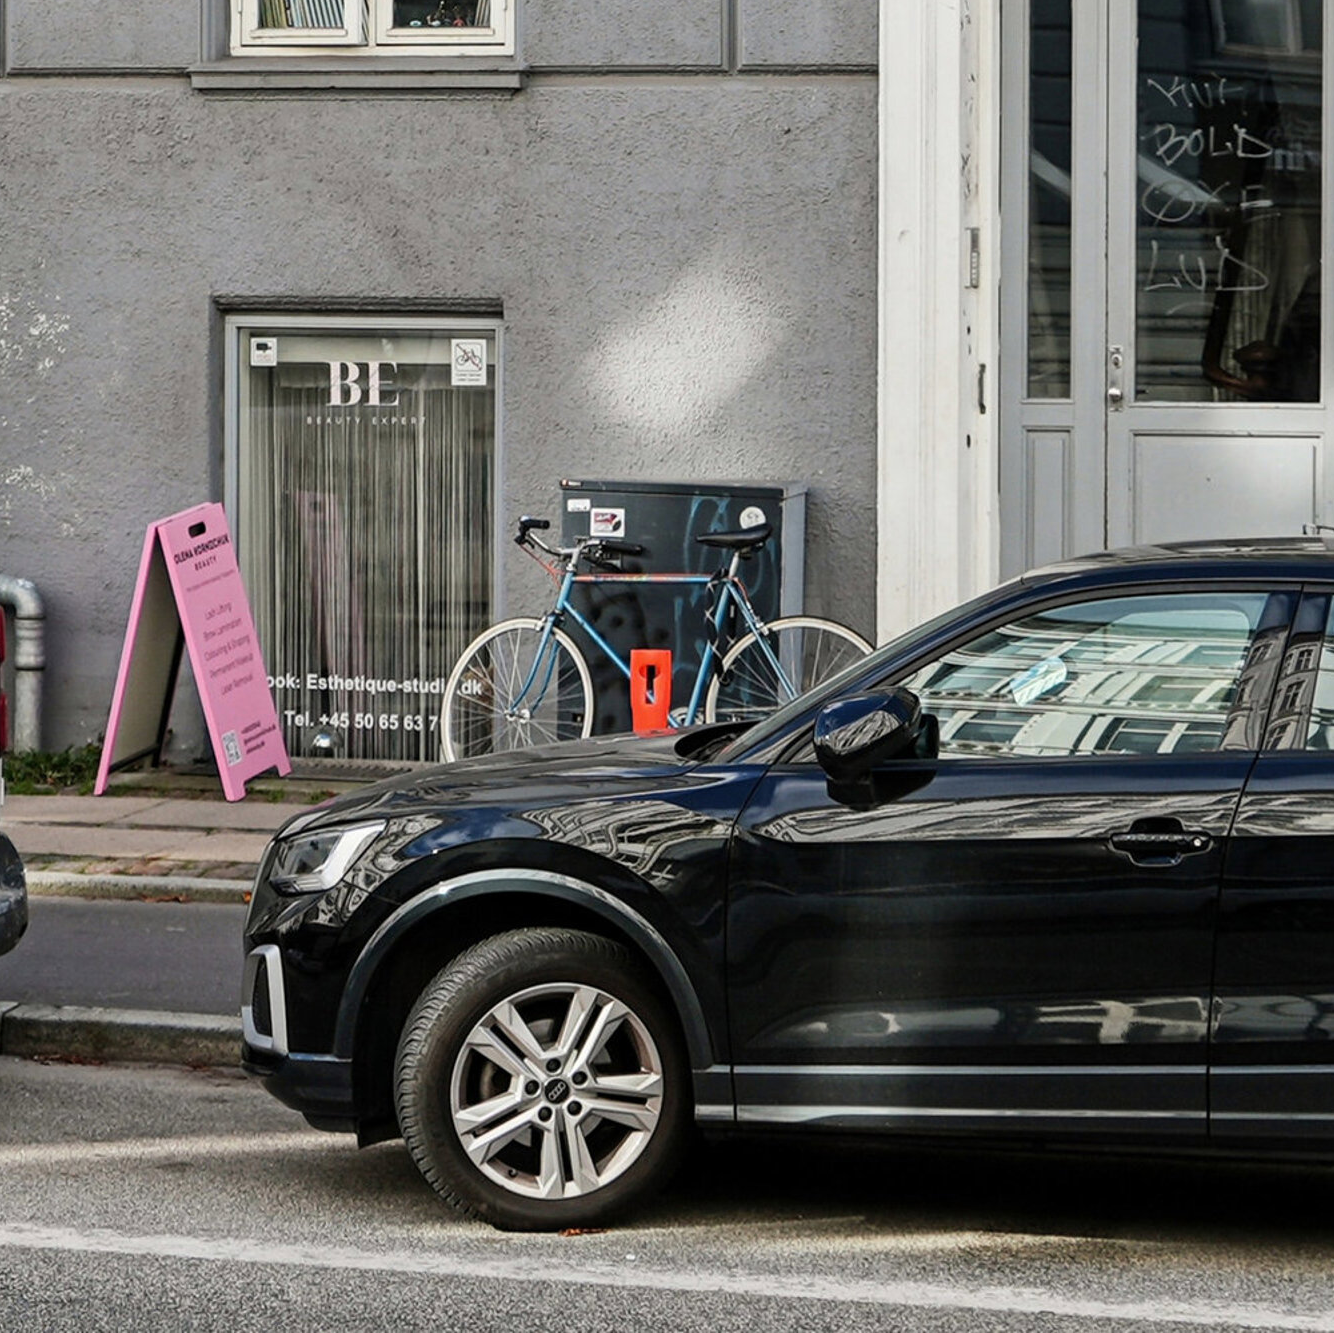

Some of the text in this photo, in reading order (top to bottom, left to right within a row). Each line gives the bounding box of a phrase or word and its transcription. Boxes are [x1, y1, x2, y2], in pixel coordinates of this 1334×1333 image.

[1141, 123, 1272, 166] BOLD
[325, 361, 400, 407] BE
[307, 417, 426, 426] BEAUTY EXPERT
[194, 555, 217, 571] BEAUTY
[306, 674, 483, 695] Esthetique-studi.dk
[284, 710, 314, 727] Tel.
[319, 712, 349, 729] +45
[354, 714, 373, 729] 50
[379, 714, 399, 730] 65
[403, 715, 423, 731] 63
